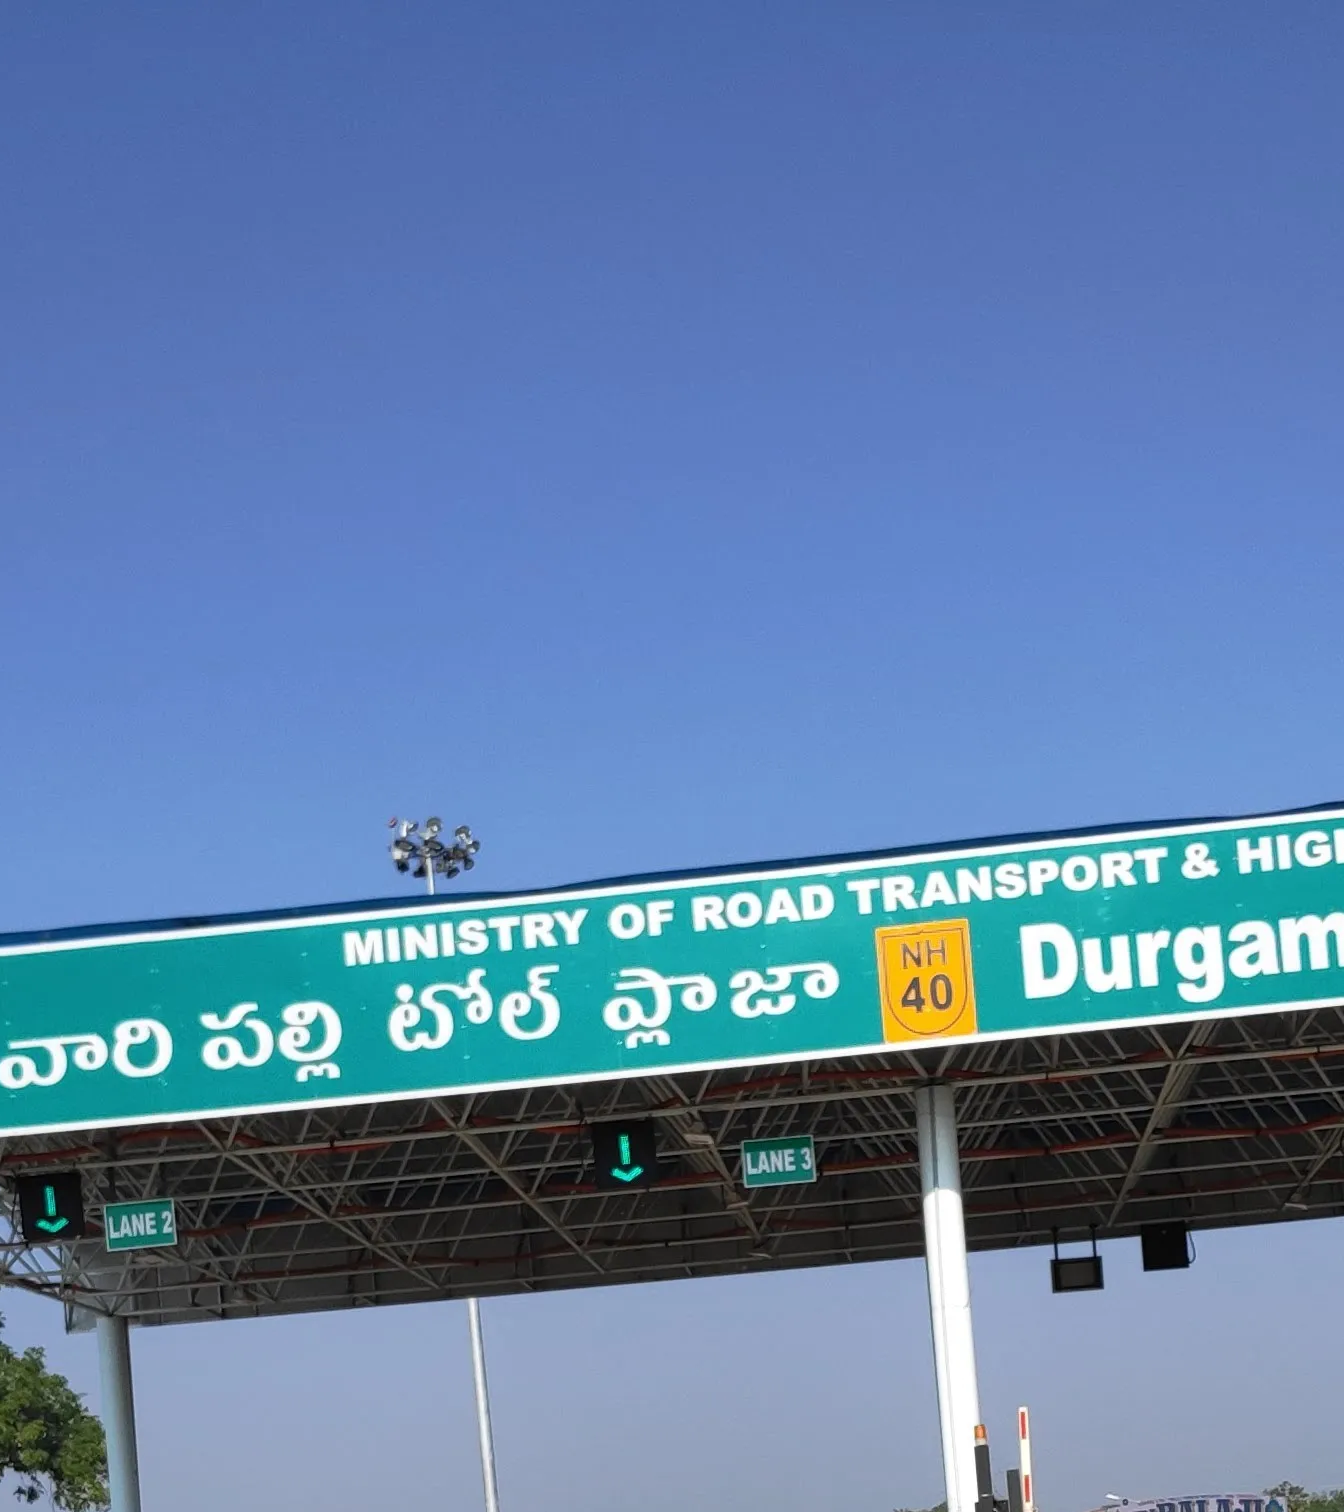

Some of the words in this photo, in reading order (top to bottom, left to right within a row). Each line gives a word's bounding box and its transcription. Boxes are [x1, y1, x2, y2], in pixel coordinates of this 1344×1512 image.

[344, 909, 588, 966] MINISTRY
[608, 900, 674, 939] OF
[692, 884, 834, 931] ROAD
[846, 847, 1168, 914] TRANSPORT
[1181, 843, 1219, 879] &
[902, 939, 947, 969] NH
[900, 974, 953, 1014] 40
[200, 1001, 342, 1081] పల్లి
[389, 965, 560, 1051] టోల్
[603, 962, 839, 1048] ప్లాజా
[746, 1149, 796, 1175] LANE
[800, 1147, 812, 1170] 3
[108, 1212, 157, 1239] LANE
[161, 1211, 172, 1233] 2
